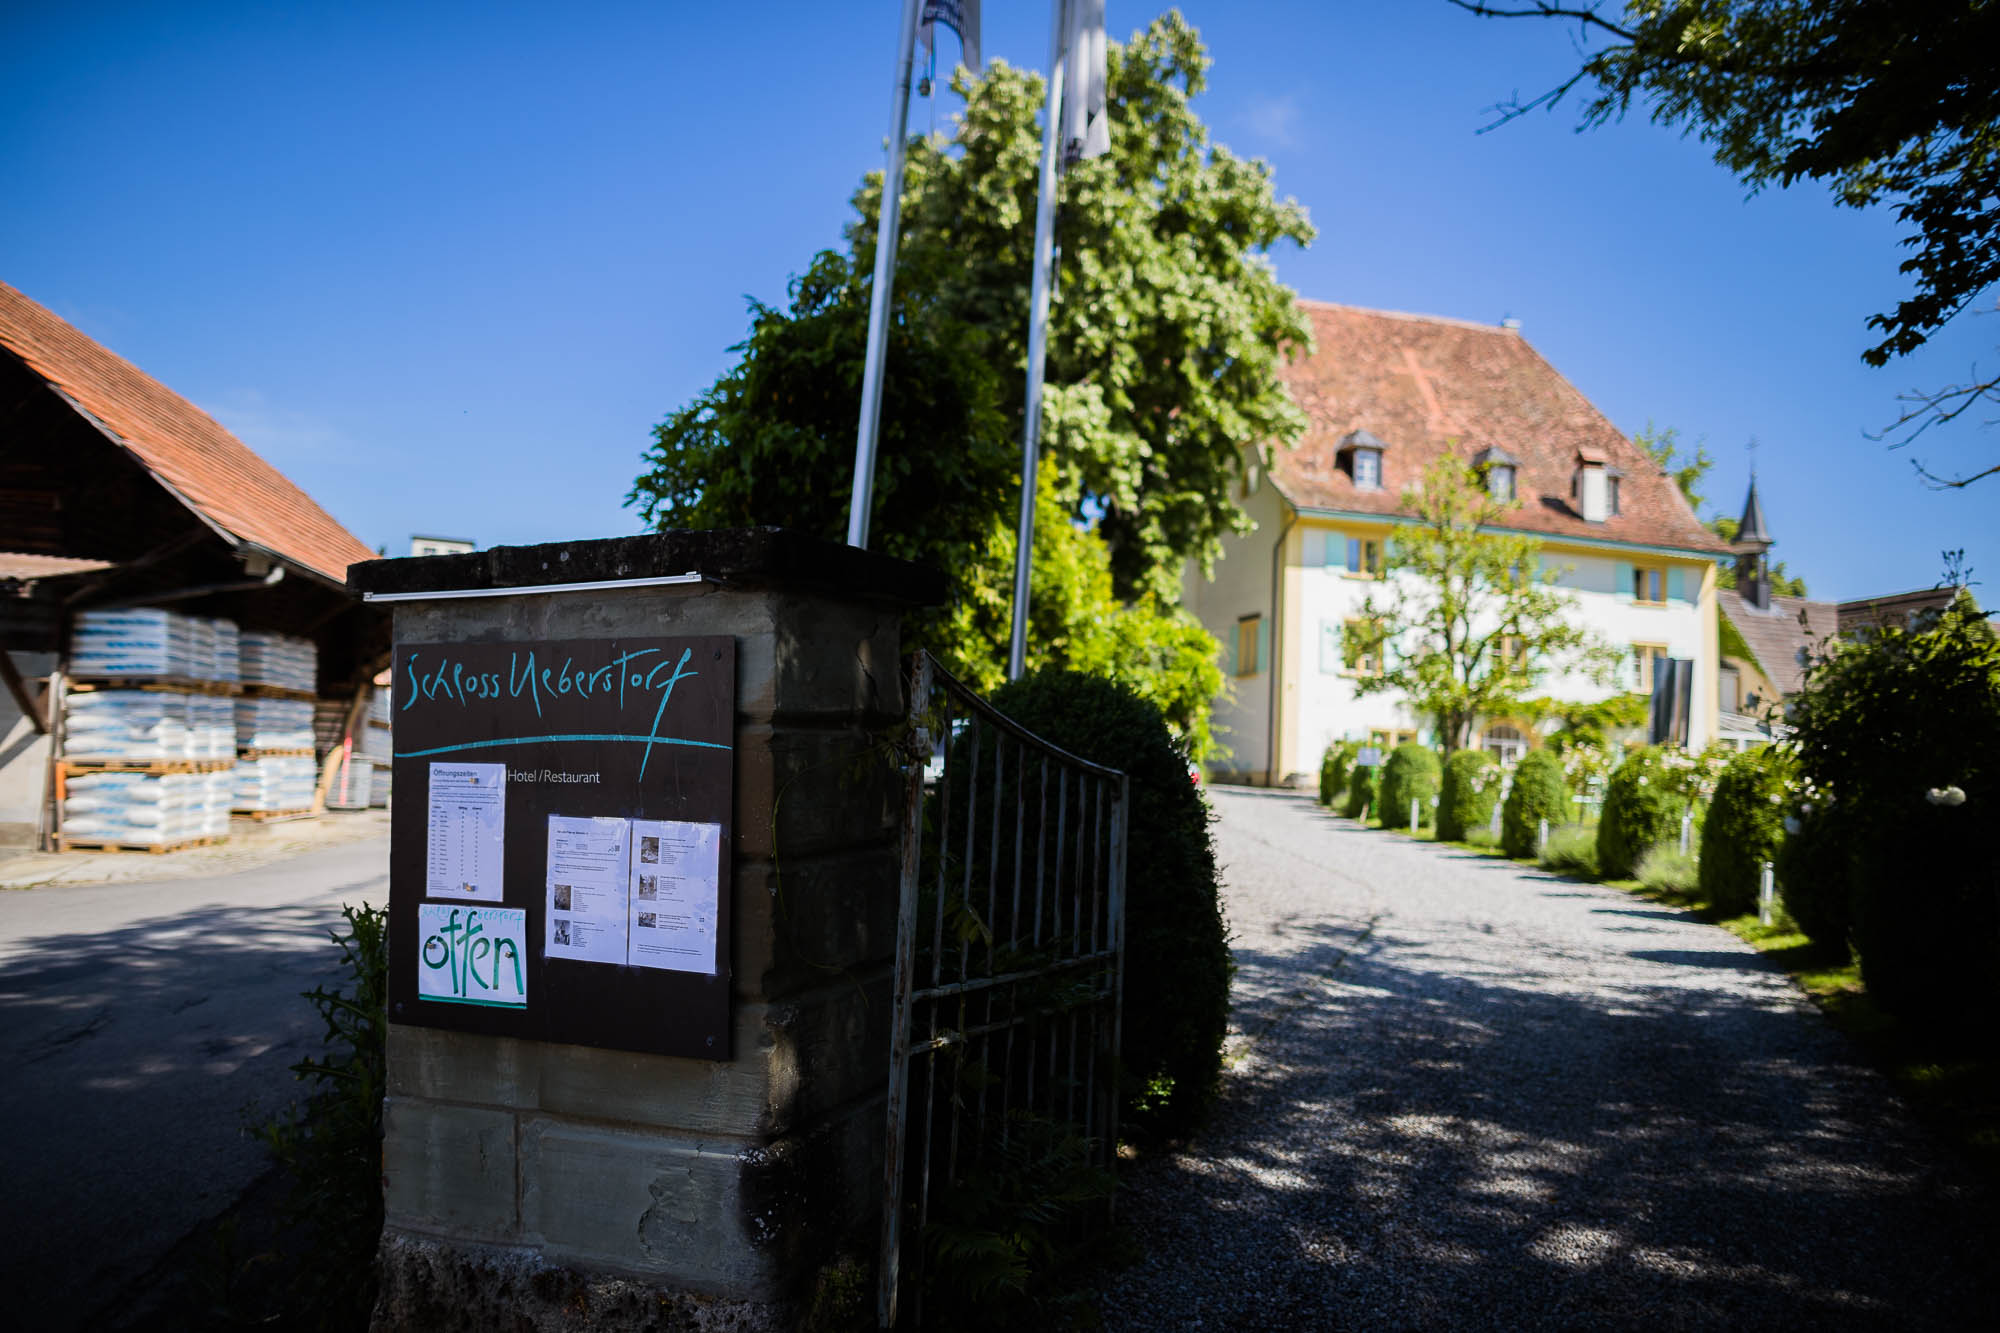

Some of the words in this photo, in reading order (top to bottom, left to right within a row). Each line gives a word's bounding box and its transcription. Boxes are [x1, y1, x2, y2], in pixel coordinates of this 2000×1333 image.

[402, 653, 500, 711] Schloss
[509, 647, 699, 783] Ueberstorf
[507, 769, 537, 783] Hotel
[422, 908, 525, 998] offen
